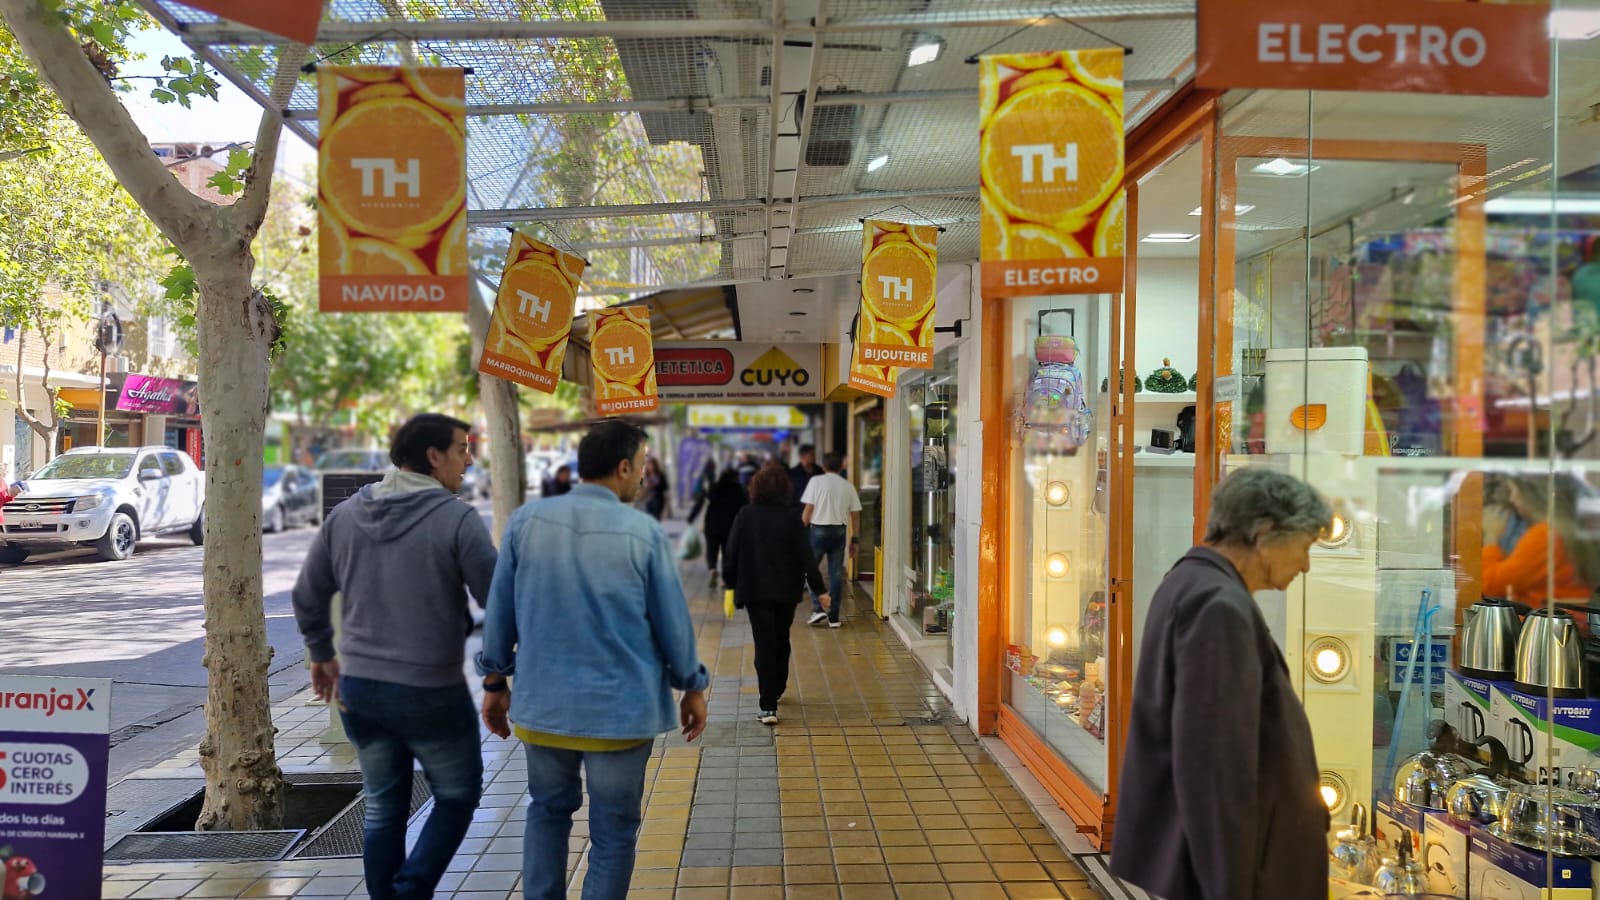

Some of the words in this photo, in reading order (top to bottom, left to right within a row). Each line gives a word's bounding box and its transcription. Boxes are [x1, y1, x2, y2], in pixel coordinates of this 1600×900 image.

[1257, 22, 1487, 67] ELECTRO
[1010, 142, 1078, 183] TH
[351, 158, 420, 198] TH
[1004, 267, 1100, 287] ELECTRO
[341, 284, 446, 302] NAVIDAD
[878, 275, 913, 301] TH
[516, 288, 552, 323] TH
[604, 346, 635, 366] TH
[864, 348, 928, 362] BIJOUTERIE
[486, 357, 552, 386] MARROQUINERÍA
[655, 360, 725, 375] IETETICA
[740, 368, 810, 387] CUYO
[851, 376, 893, 392] MARROQUINERÍA
[127, 380, 173, 404] Agatha
[601, 399, 654, 412] BIJOUTERIE
[0, 687, 96, 717] ranjaX
[12, 752, 73, 765] CUOTAS
[11, 767, 54, 780] CERO
[10, 779, 74, 796] INTERÉS
[0, 812, 19, 824] dos
[22, 813, 39, 825] los
[41, 813, 65, 825] días
